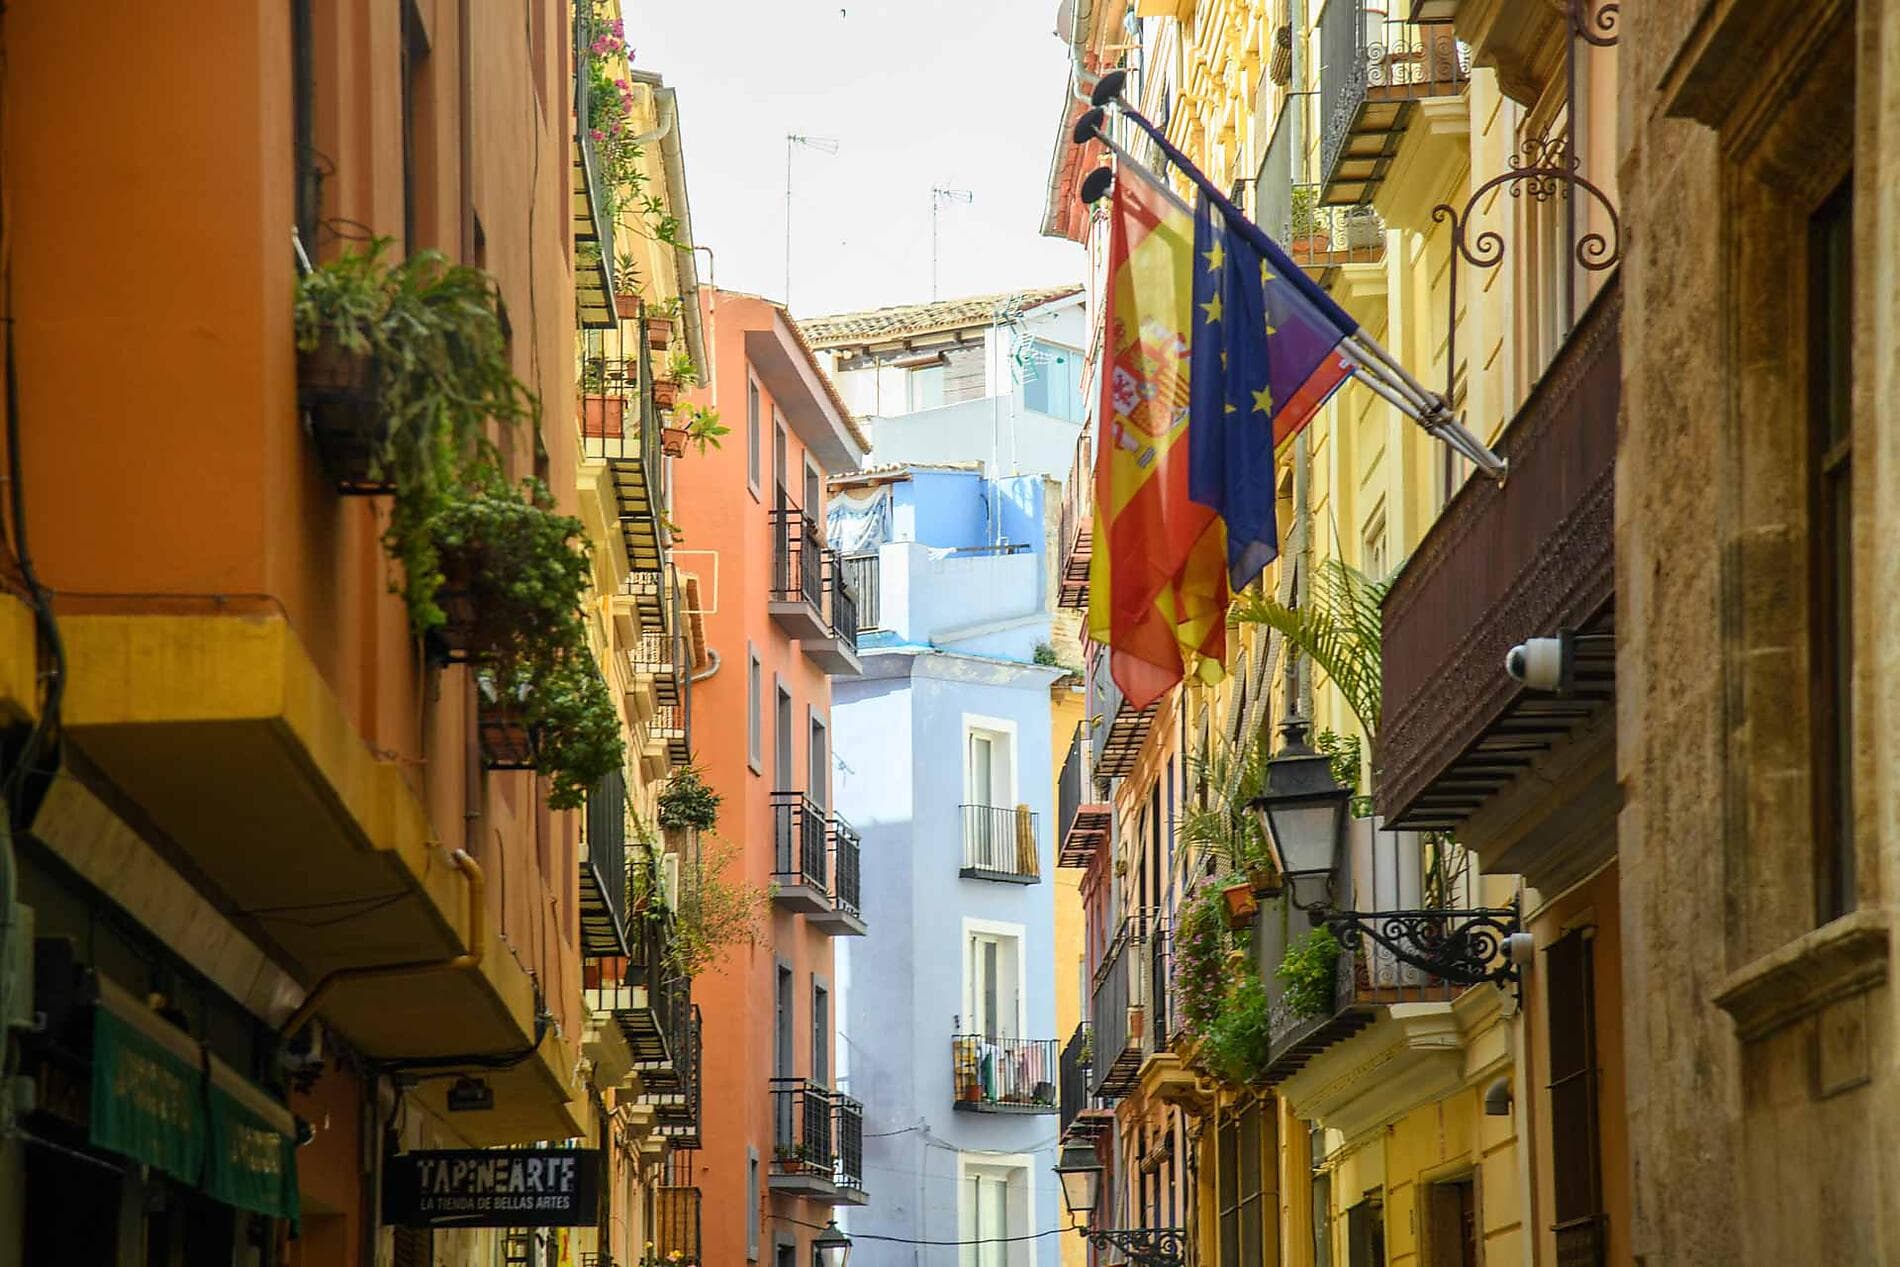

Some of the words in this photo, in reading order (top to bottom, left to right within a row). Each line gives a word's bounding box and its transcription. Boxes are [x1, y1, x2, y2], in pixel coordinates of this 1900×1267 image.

[420, 1197, 434, 1210] LA
[438, 1197, 475, 1210] TIENDA
[478, 1196, 492, 1210] DE
[494, 1195, 535, 1210] BELLAS
[535, 1195, 570, 1209] ARTES
